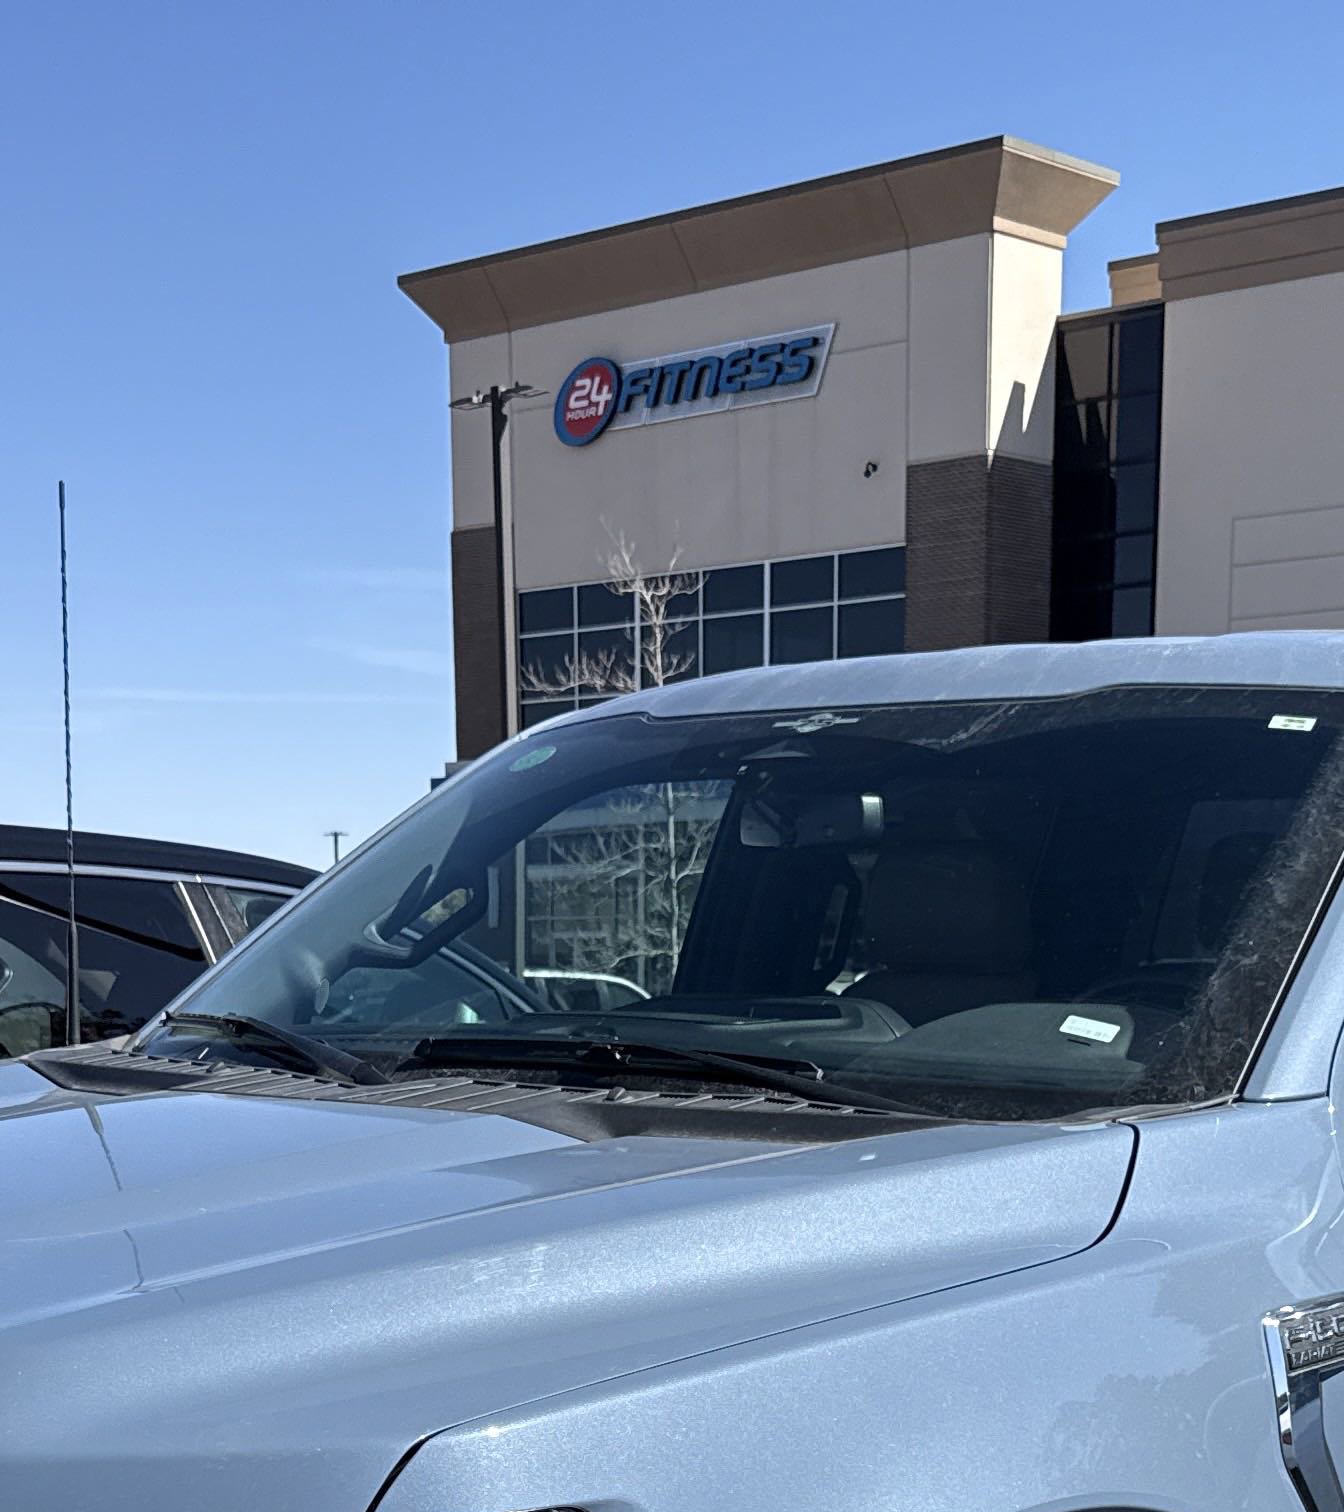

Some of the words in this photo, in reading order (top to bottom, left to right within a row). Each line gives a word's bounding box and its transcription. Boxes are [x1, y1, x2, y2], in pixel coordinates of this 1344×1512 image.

[568, 376, 613, 416] 24
[617, 337, 819, 412] FITNESS
[565, 406, 597, 421] HOUR
